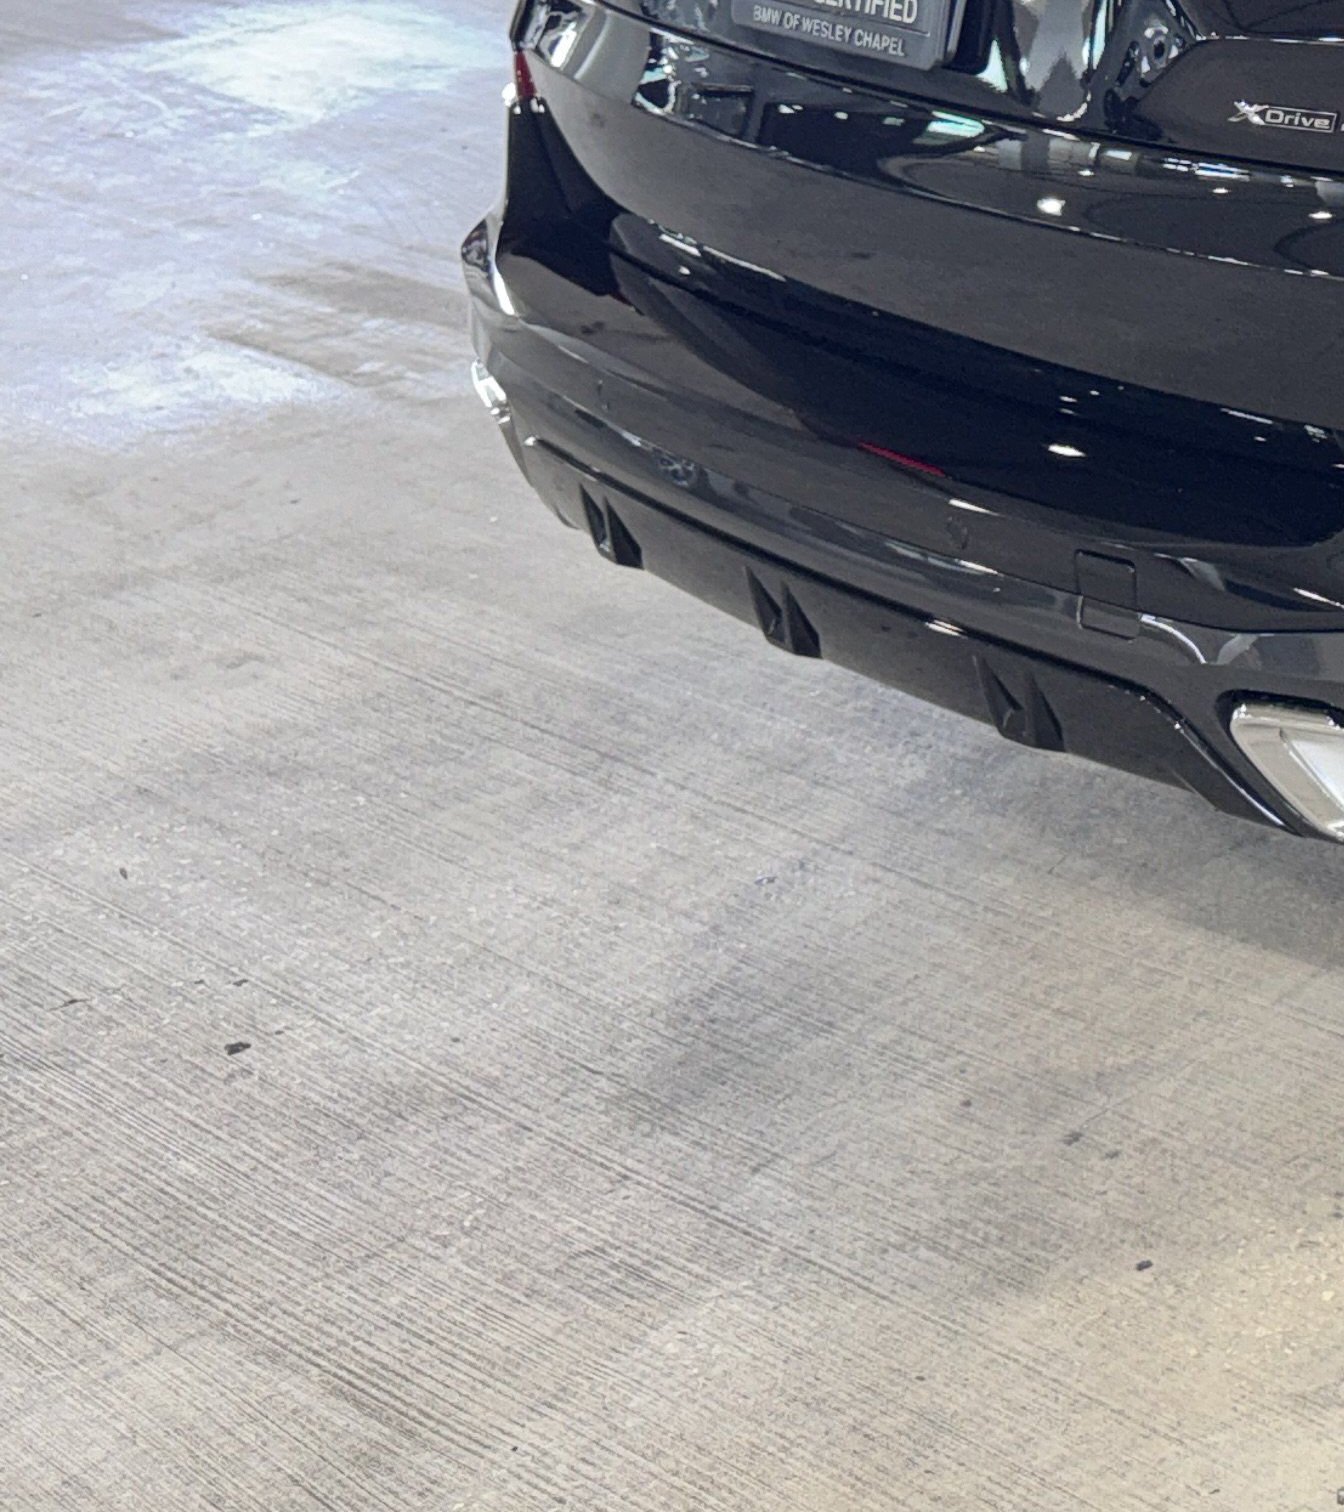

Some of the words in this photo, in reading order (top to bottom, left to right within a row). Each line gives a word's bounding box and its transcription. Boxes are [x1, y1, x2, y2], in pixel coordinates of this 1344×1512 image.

[753, 4, 782, 26] BMW
[783, 11, 800, 31] OF
[802, 16, 852, 43] WESLEY
[854, 28, 905, 57] CHAPEL
